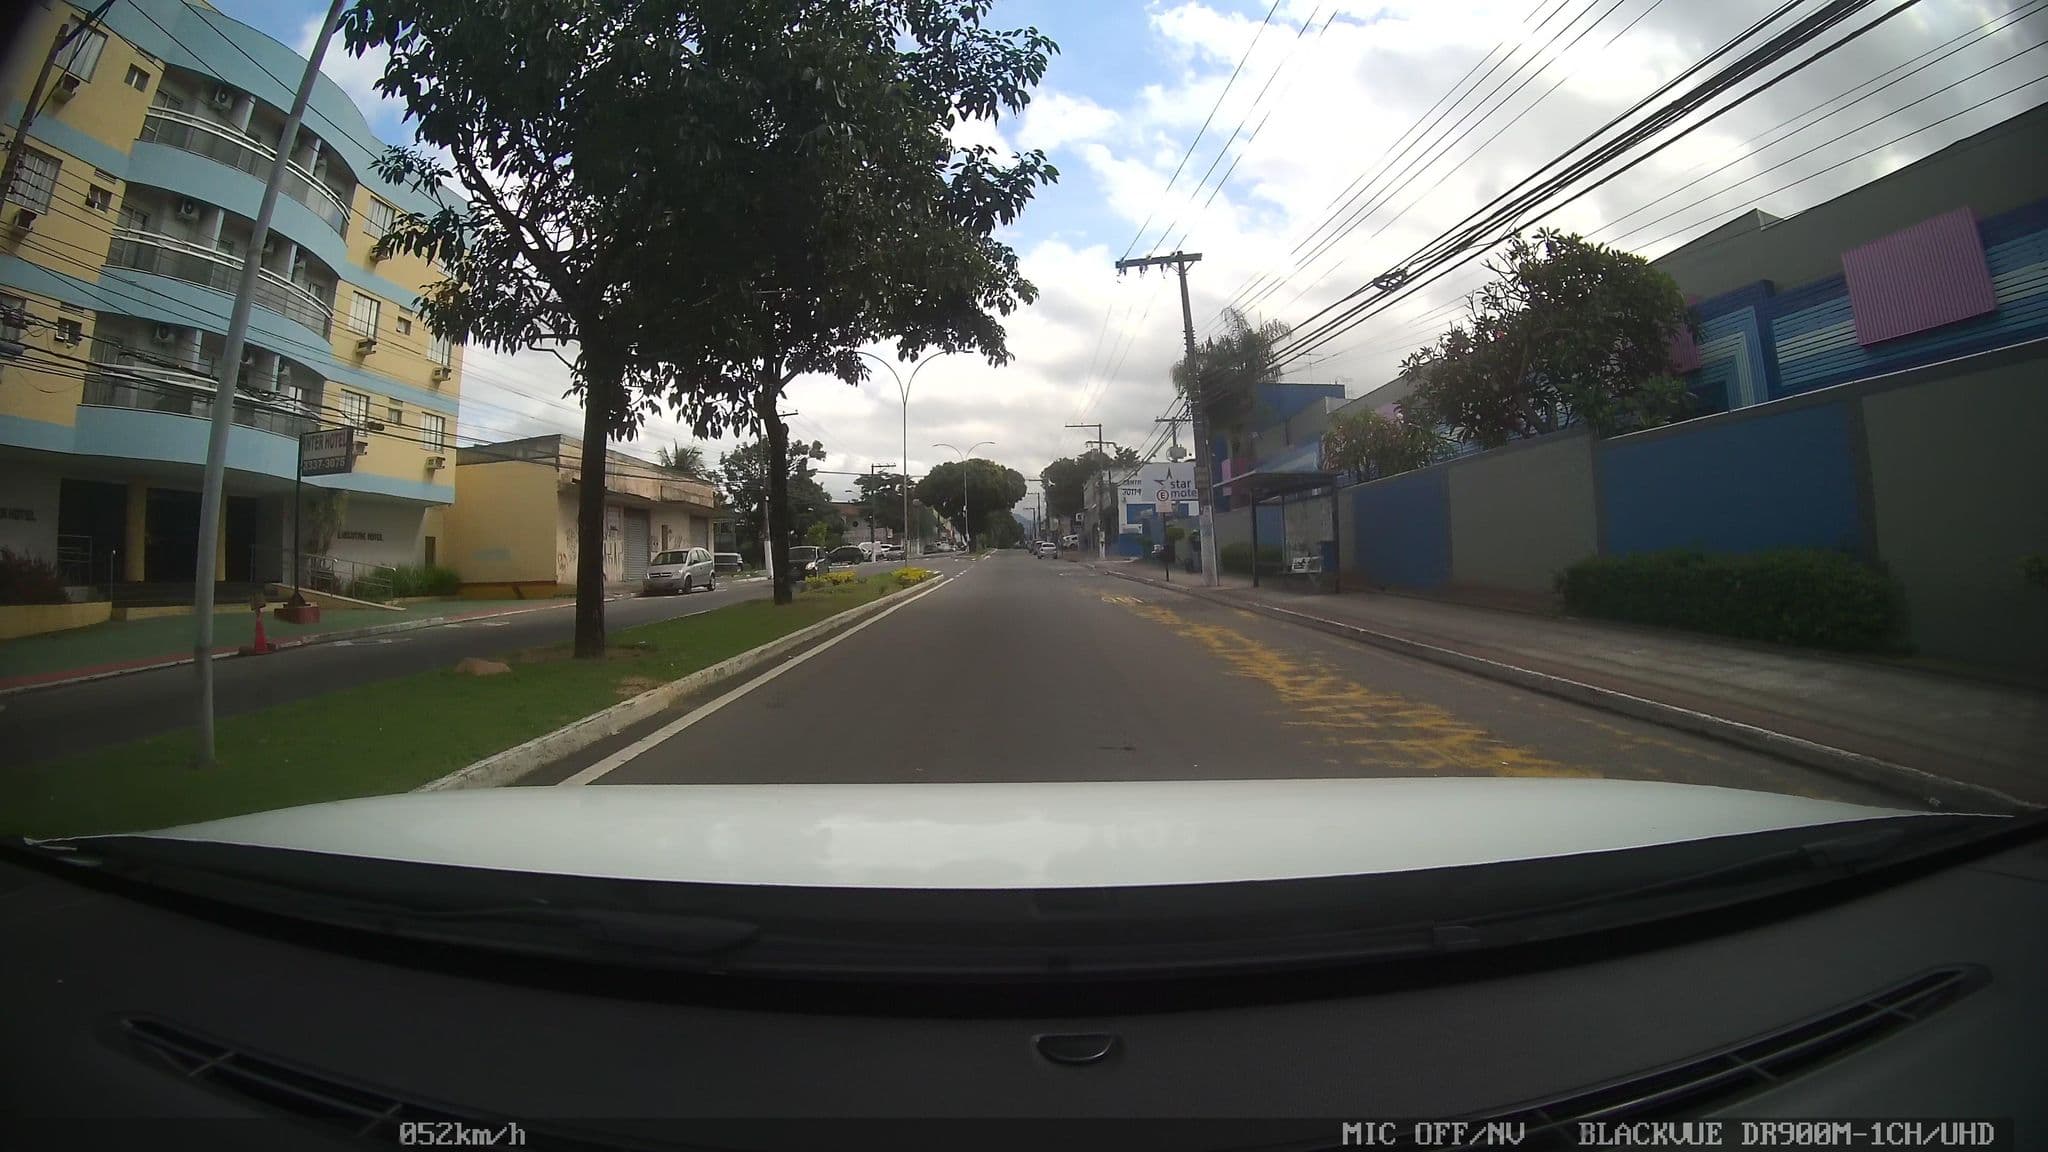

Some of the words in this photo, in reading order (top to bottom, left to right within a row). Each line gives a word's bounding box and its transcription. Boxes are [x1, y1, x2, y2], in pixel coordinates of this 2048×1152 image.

[322, 433, 342, 447] HOTEL
[1170, 480, 1192, 489] star
[1171, 489, 1197, 498] mote
